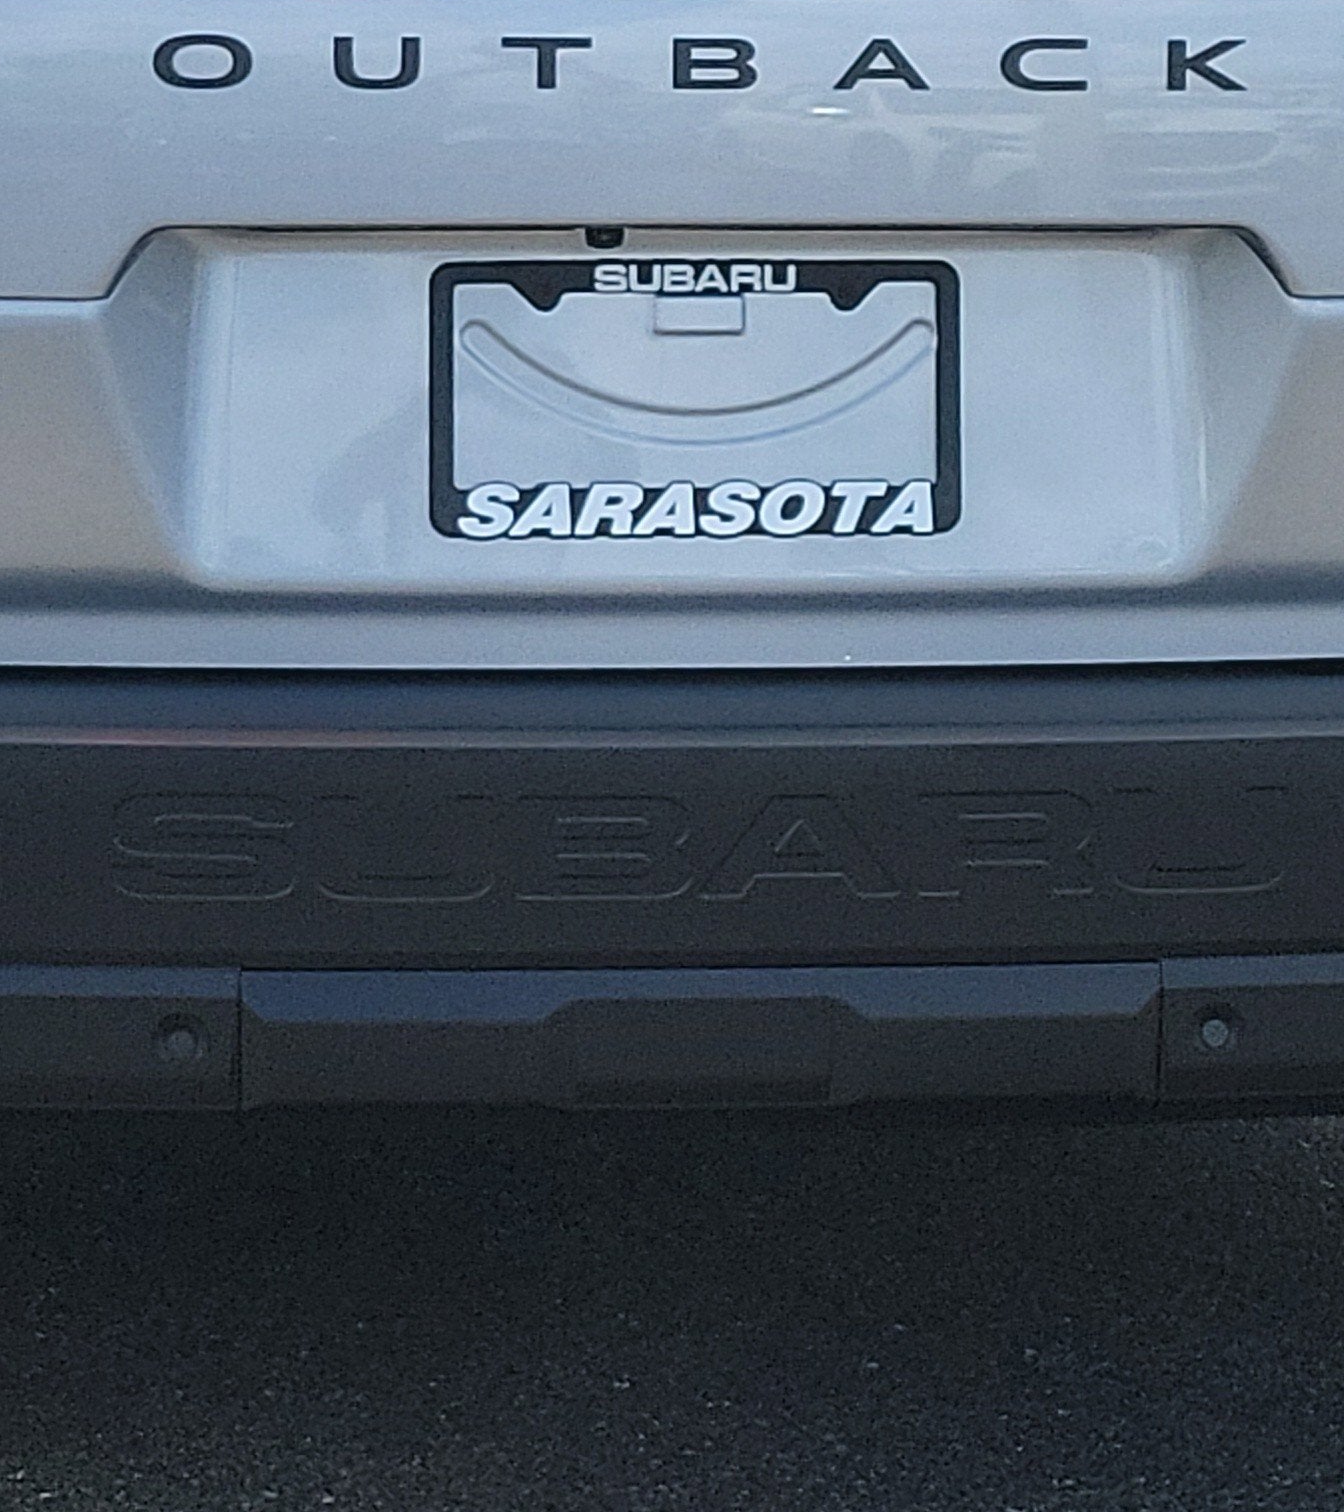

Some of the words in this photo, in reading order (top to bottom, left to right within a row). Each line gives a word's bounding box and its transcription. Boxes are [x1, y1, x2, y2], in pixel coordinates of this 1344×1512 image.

[150, 34, 1250, 92] OUTBACK
[593, 262, 799, 294] SUBARU
[456, 479, 936, 539] SARASOTA
[113, 785, 1287, 902] SUBARU
